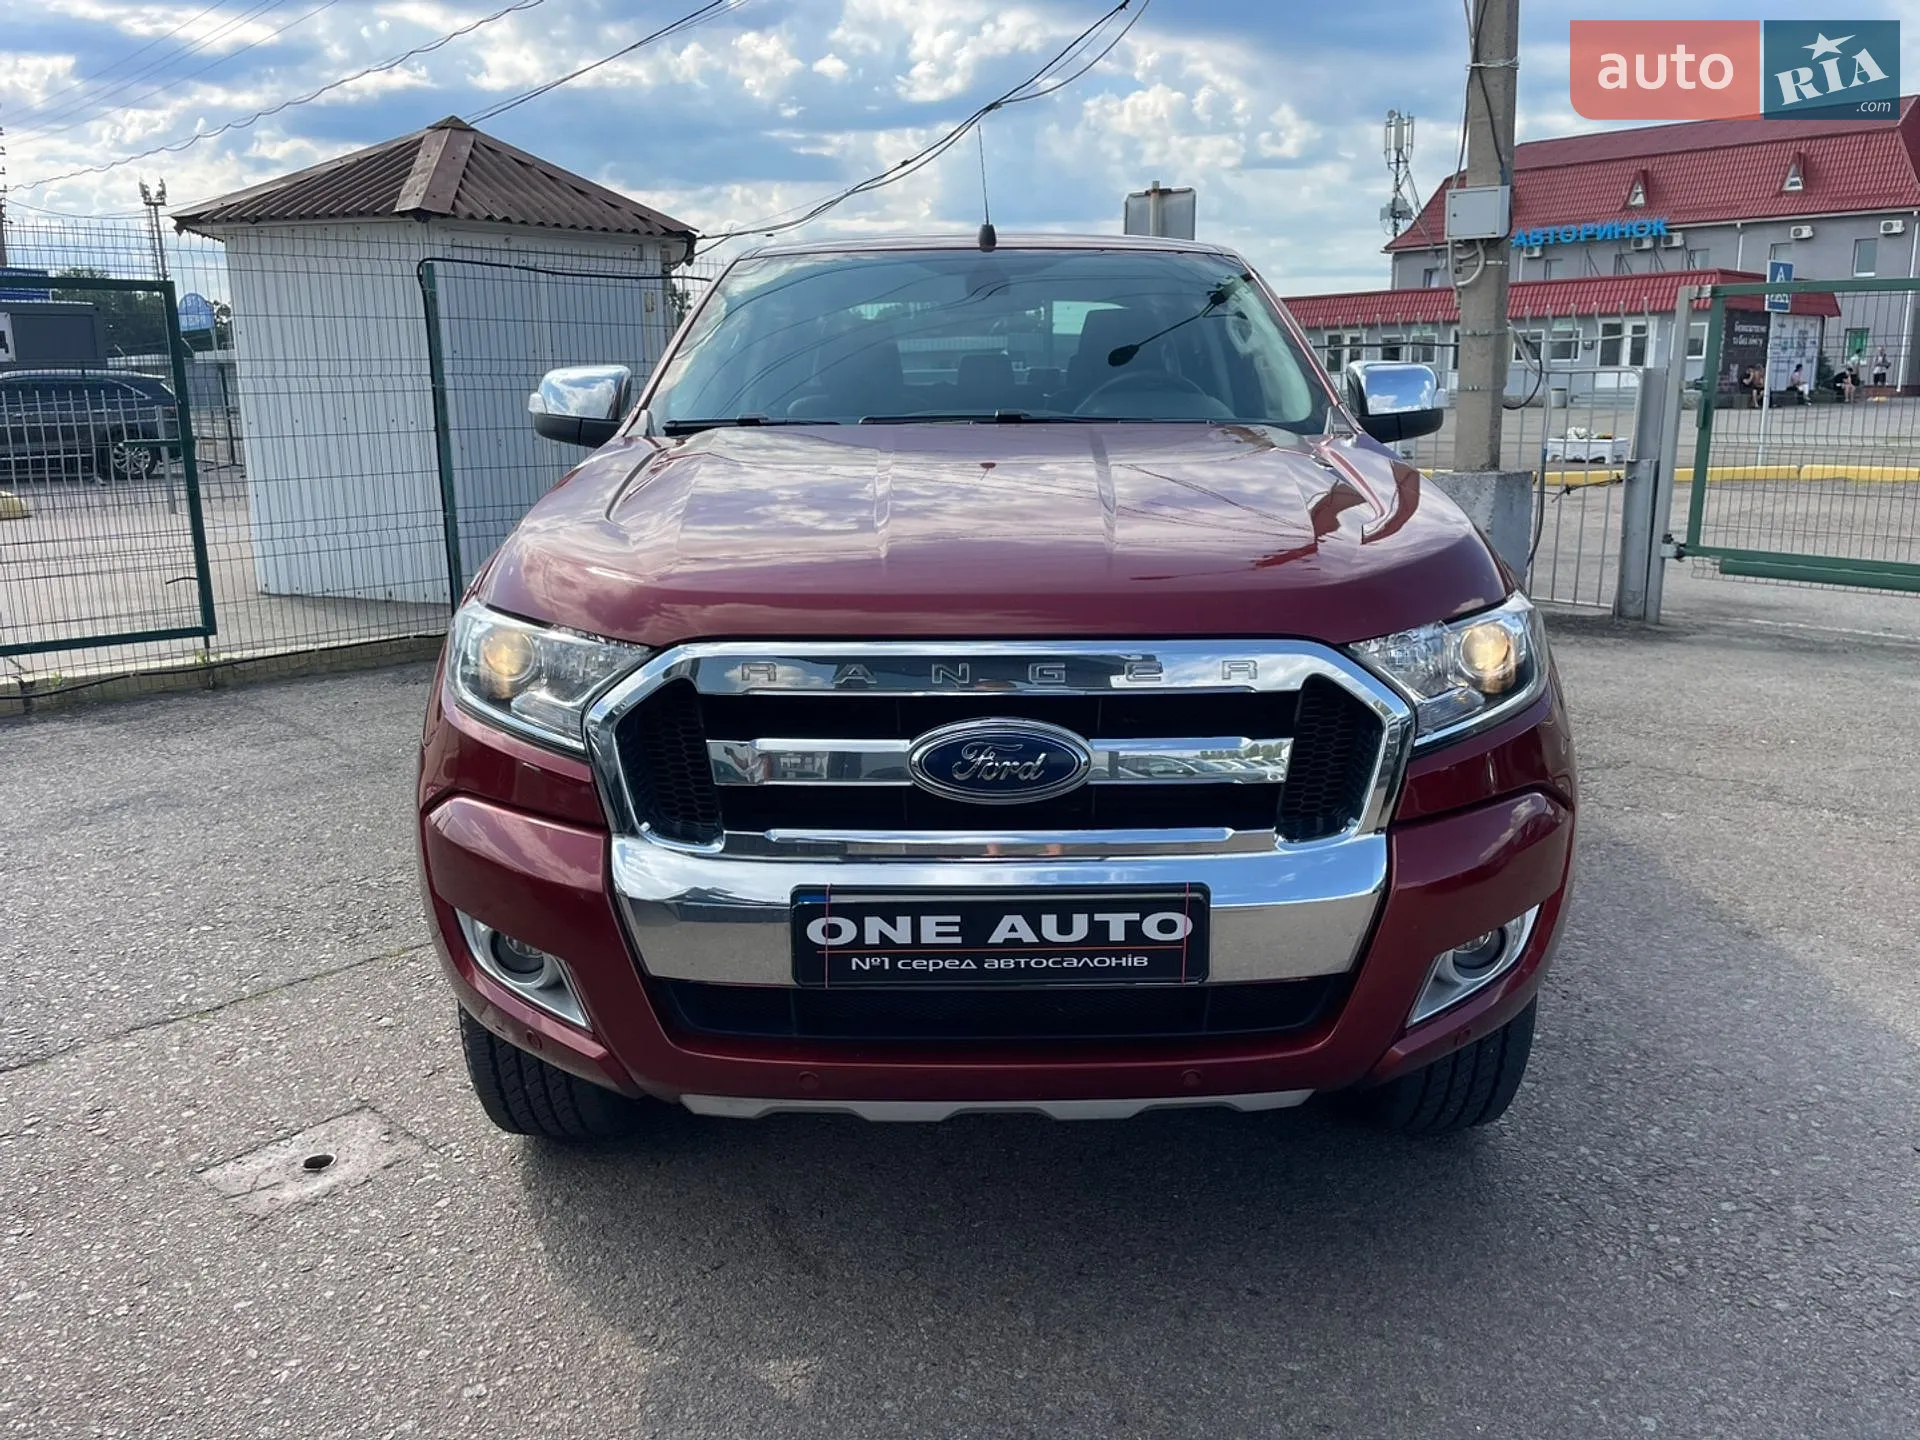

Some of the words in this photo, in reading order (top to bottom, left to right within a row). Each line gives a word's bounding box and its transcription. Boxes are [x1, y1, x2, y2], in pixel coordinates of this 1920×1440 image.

[1511, 217, 1669, 248] АВТОРИНОК
[741, 659, 1258, 684] RANGER
[951, 740, 1048, 783] Ford
[805, 913, 963, 946] ONE
[986, 911, 1194, 944] AUTO
[897, 957, 979, 972] серед
[983, 953, 1150, 969] автосалонів
